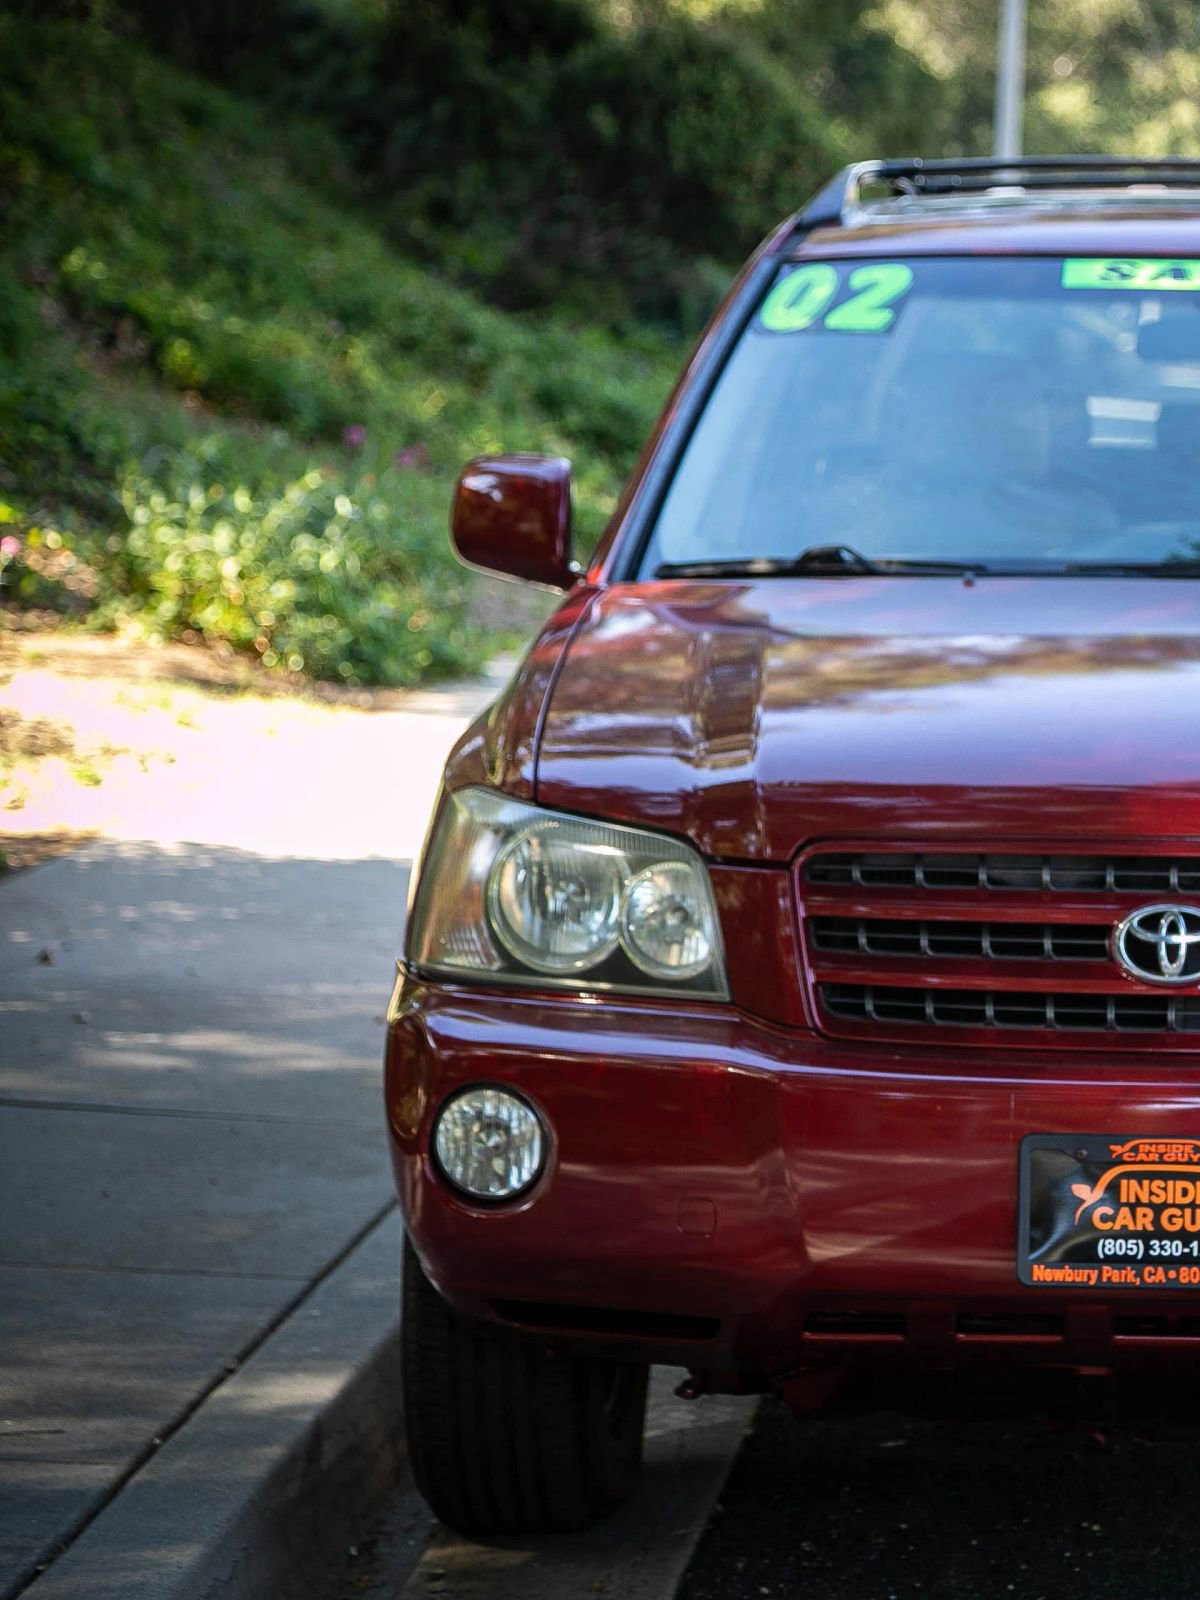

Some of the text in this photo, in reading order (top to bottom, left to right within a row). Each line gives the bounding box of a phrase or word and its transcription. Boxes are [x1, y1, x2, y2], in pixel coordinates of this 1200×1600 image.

[759, 262, 914, 333] 02
[1122, 1152, 1160, 1162] CAR
[1138, 1144, 1195, 1154] INSIDE
[1091, 1207, 1155, 1232] CAR
[1097, 1238, 1144, 1260] (805)
[1032, 1264, 1098, 1286] Newbury
[1102, 1265, 1141, 1286] Park,
